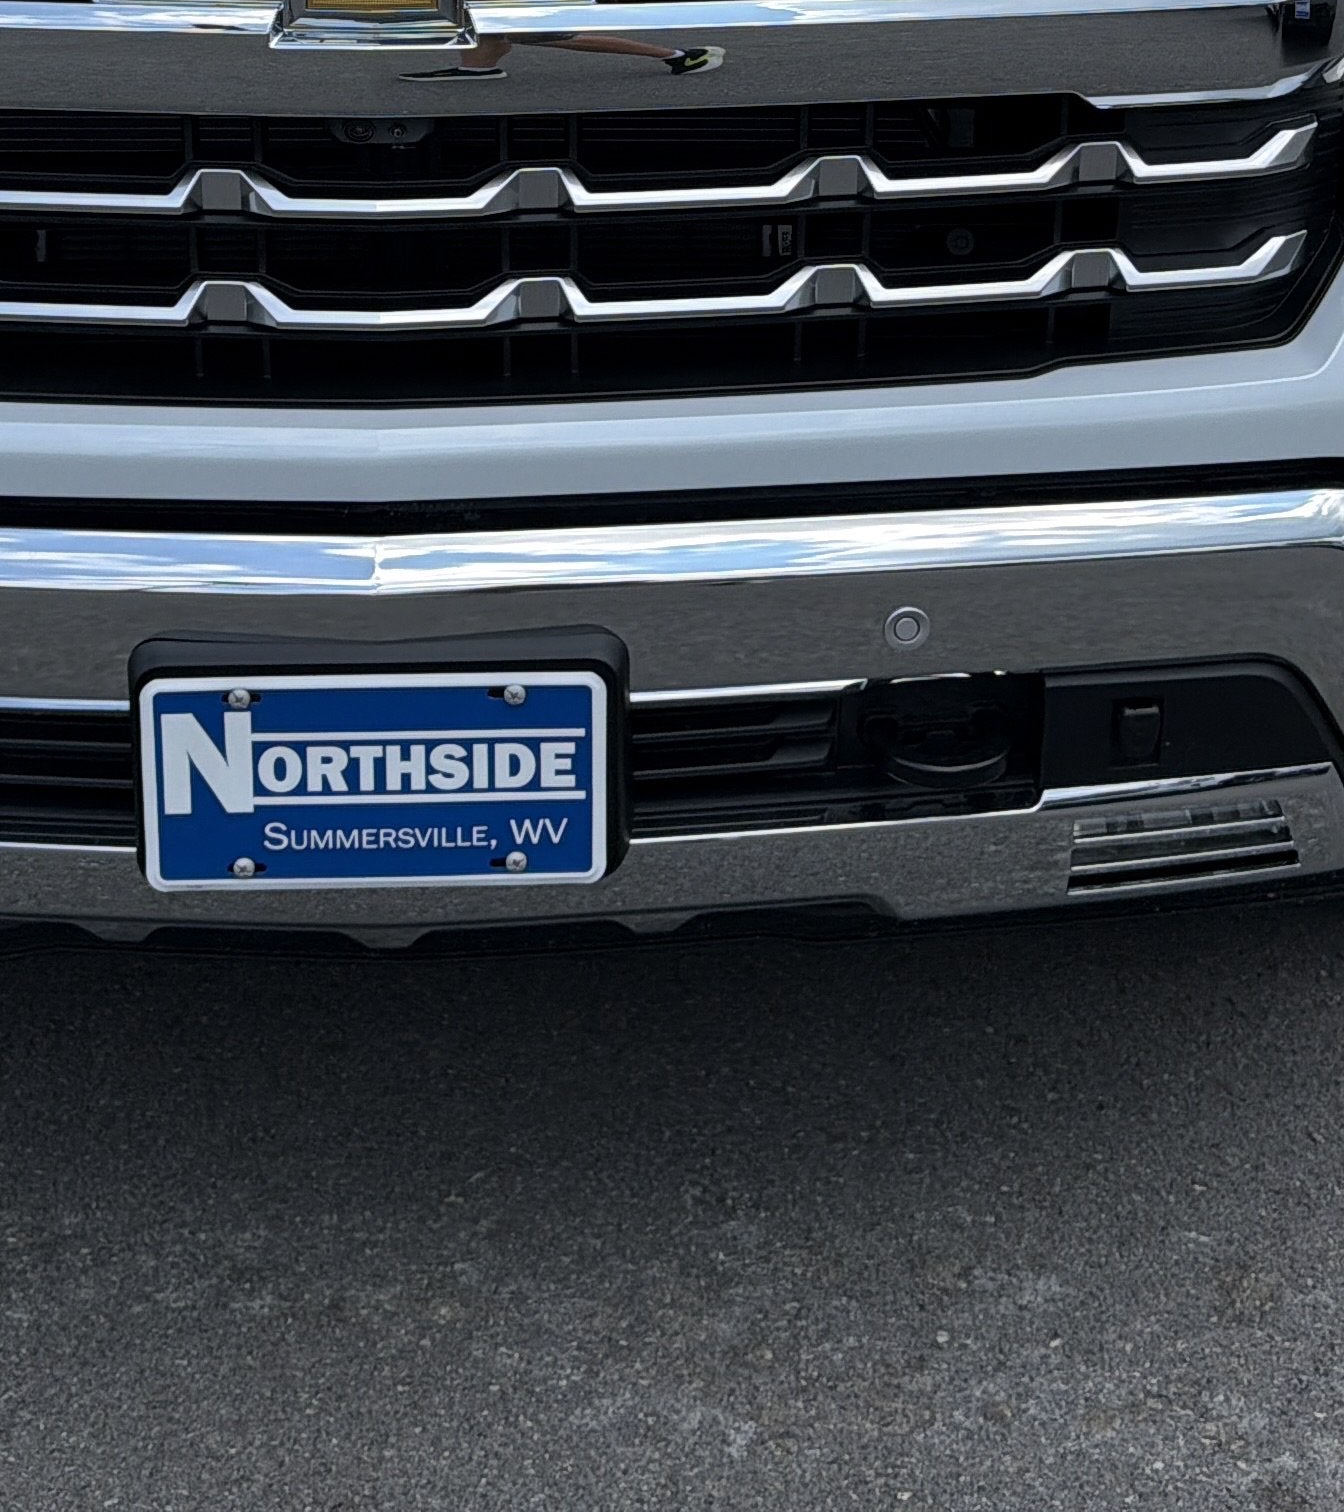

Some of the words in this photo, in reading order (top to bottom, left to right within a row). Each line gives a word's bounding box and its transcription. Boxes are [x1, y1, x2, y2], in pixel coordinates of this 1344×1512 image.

[160, 710, 577, 816] NORTHSIDE
[263, 821, 498, 851] SUMMERSVILLE,
[510, 816, 569, 846] WV
